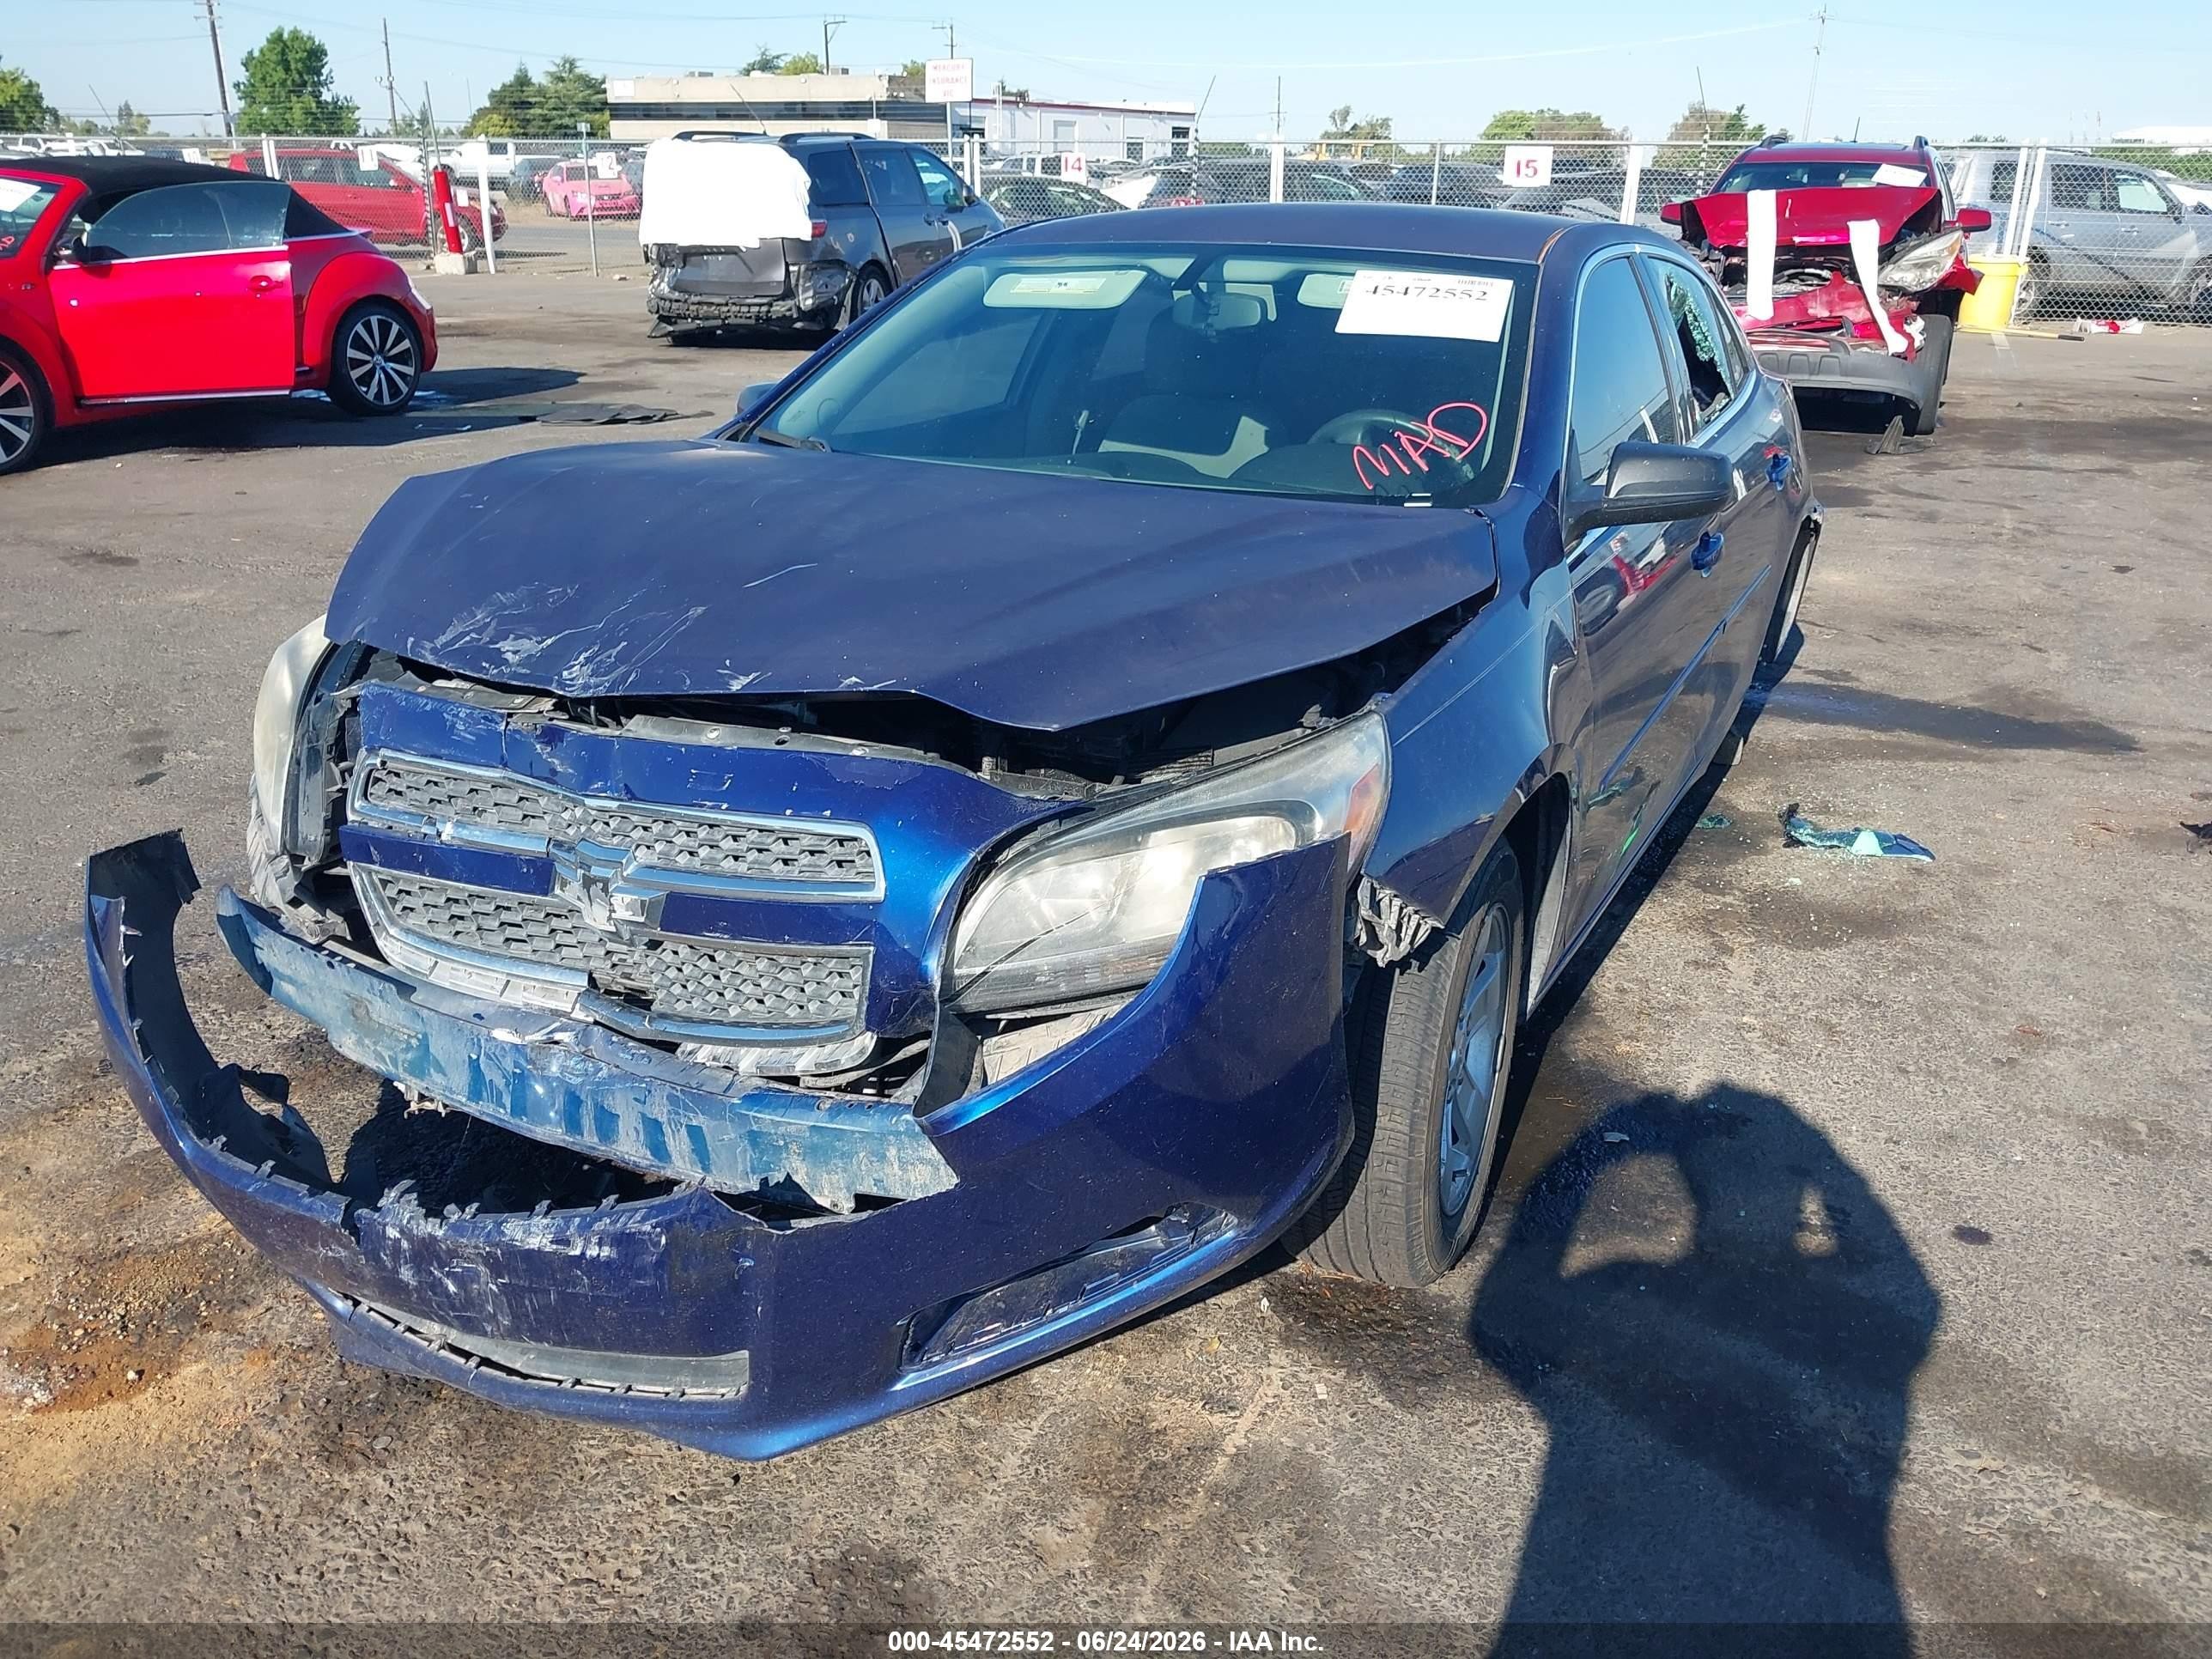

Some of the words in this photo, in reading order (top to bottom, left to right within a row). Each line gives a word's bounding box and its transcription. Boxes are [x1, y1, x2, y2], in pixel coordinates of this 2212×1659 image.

[1064, 156, 1084, 173] 14
[1515, 159, 1539, 179] 15
[1365, 284, 1488, 301] 45472552
[1352, 401, 1488, 490] MAD
